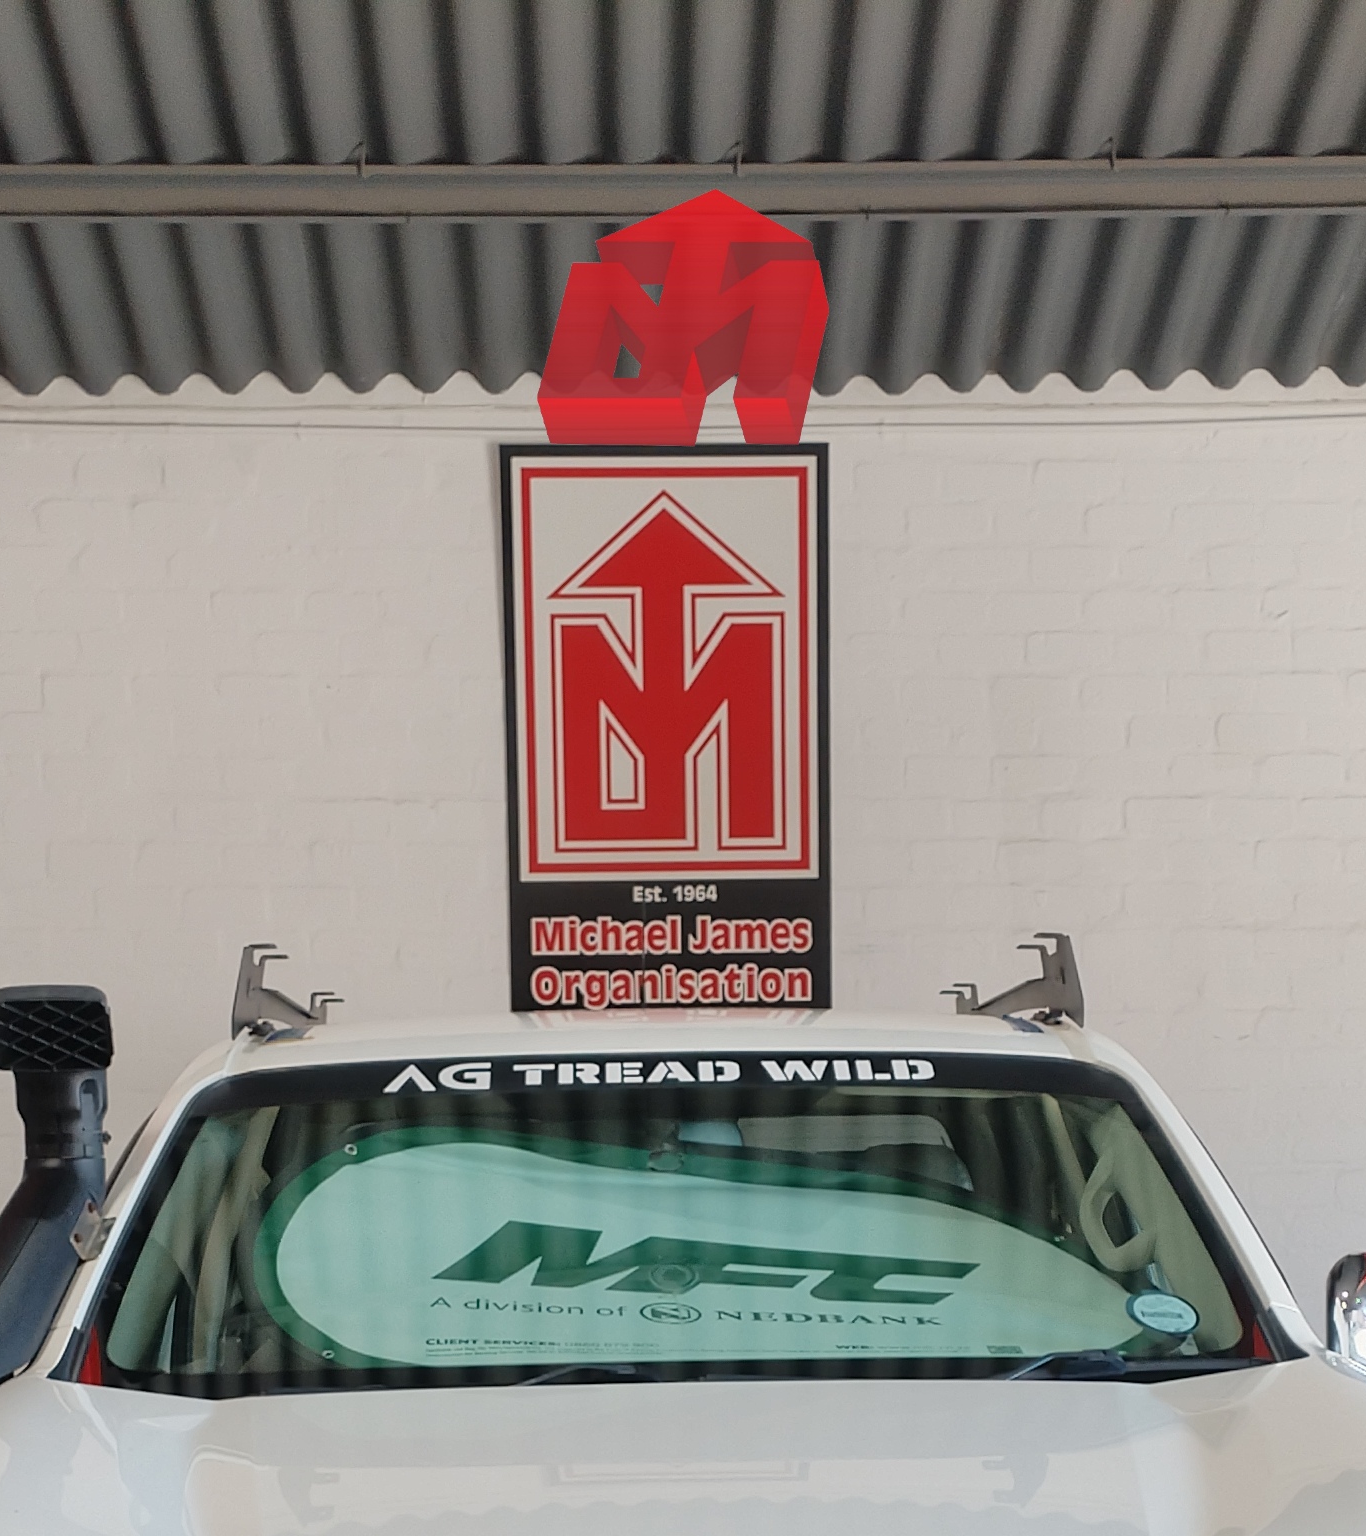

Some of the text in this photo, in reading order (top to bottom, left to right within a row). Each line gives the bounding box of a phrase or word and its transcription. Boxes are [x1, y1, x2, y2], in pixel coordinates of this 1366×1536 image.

[632, 885, 718, 902] Est. 1964
[531, 914, 813, 955] Michael James
[531, 963, 813, 1010] Organisation
[512, 1060, 741, 1085] TREAD
[760, 1058, 935, 1082] WILD
[432, 1221, 980, 1305] MFC
[430, 1297, 943, 1325] A division of NEDBANK
